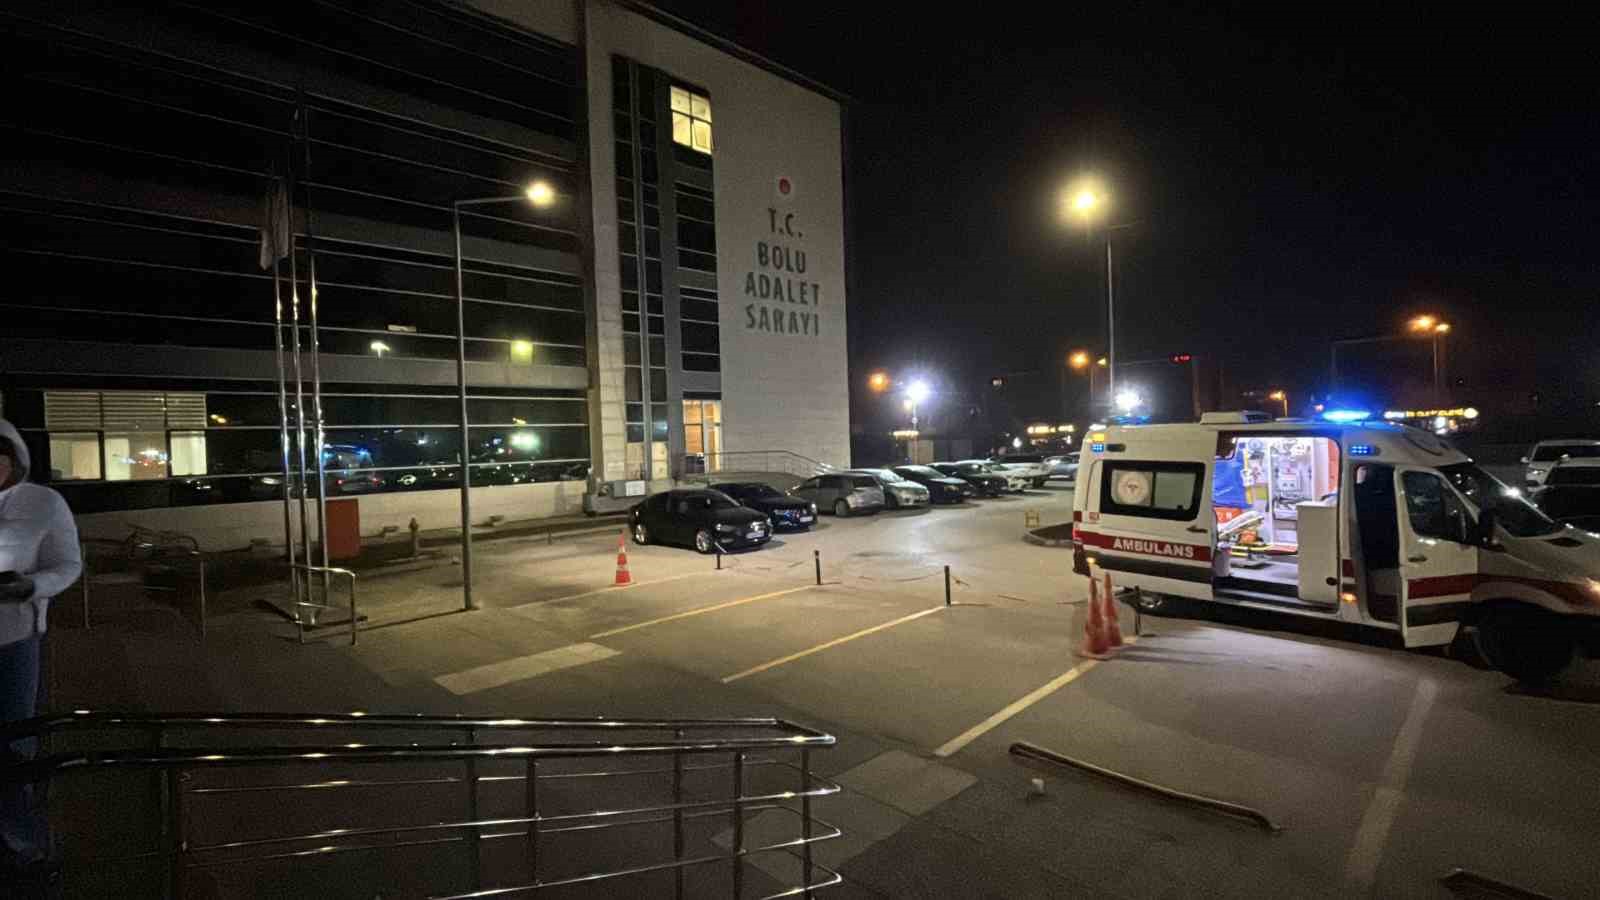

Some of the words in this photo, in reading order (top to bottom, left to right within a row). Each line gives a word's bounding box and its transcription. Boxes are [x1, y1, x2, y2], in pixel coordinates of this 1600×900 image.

[768, 207, 803, 238] T.C.
[757, 241, 806, 273] BOLU
[744, 272, 820, 305] ADALET
[745, 304, 819, 336] SARAYI
[1113, 537, 1194, 558] AMBULANS
